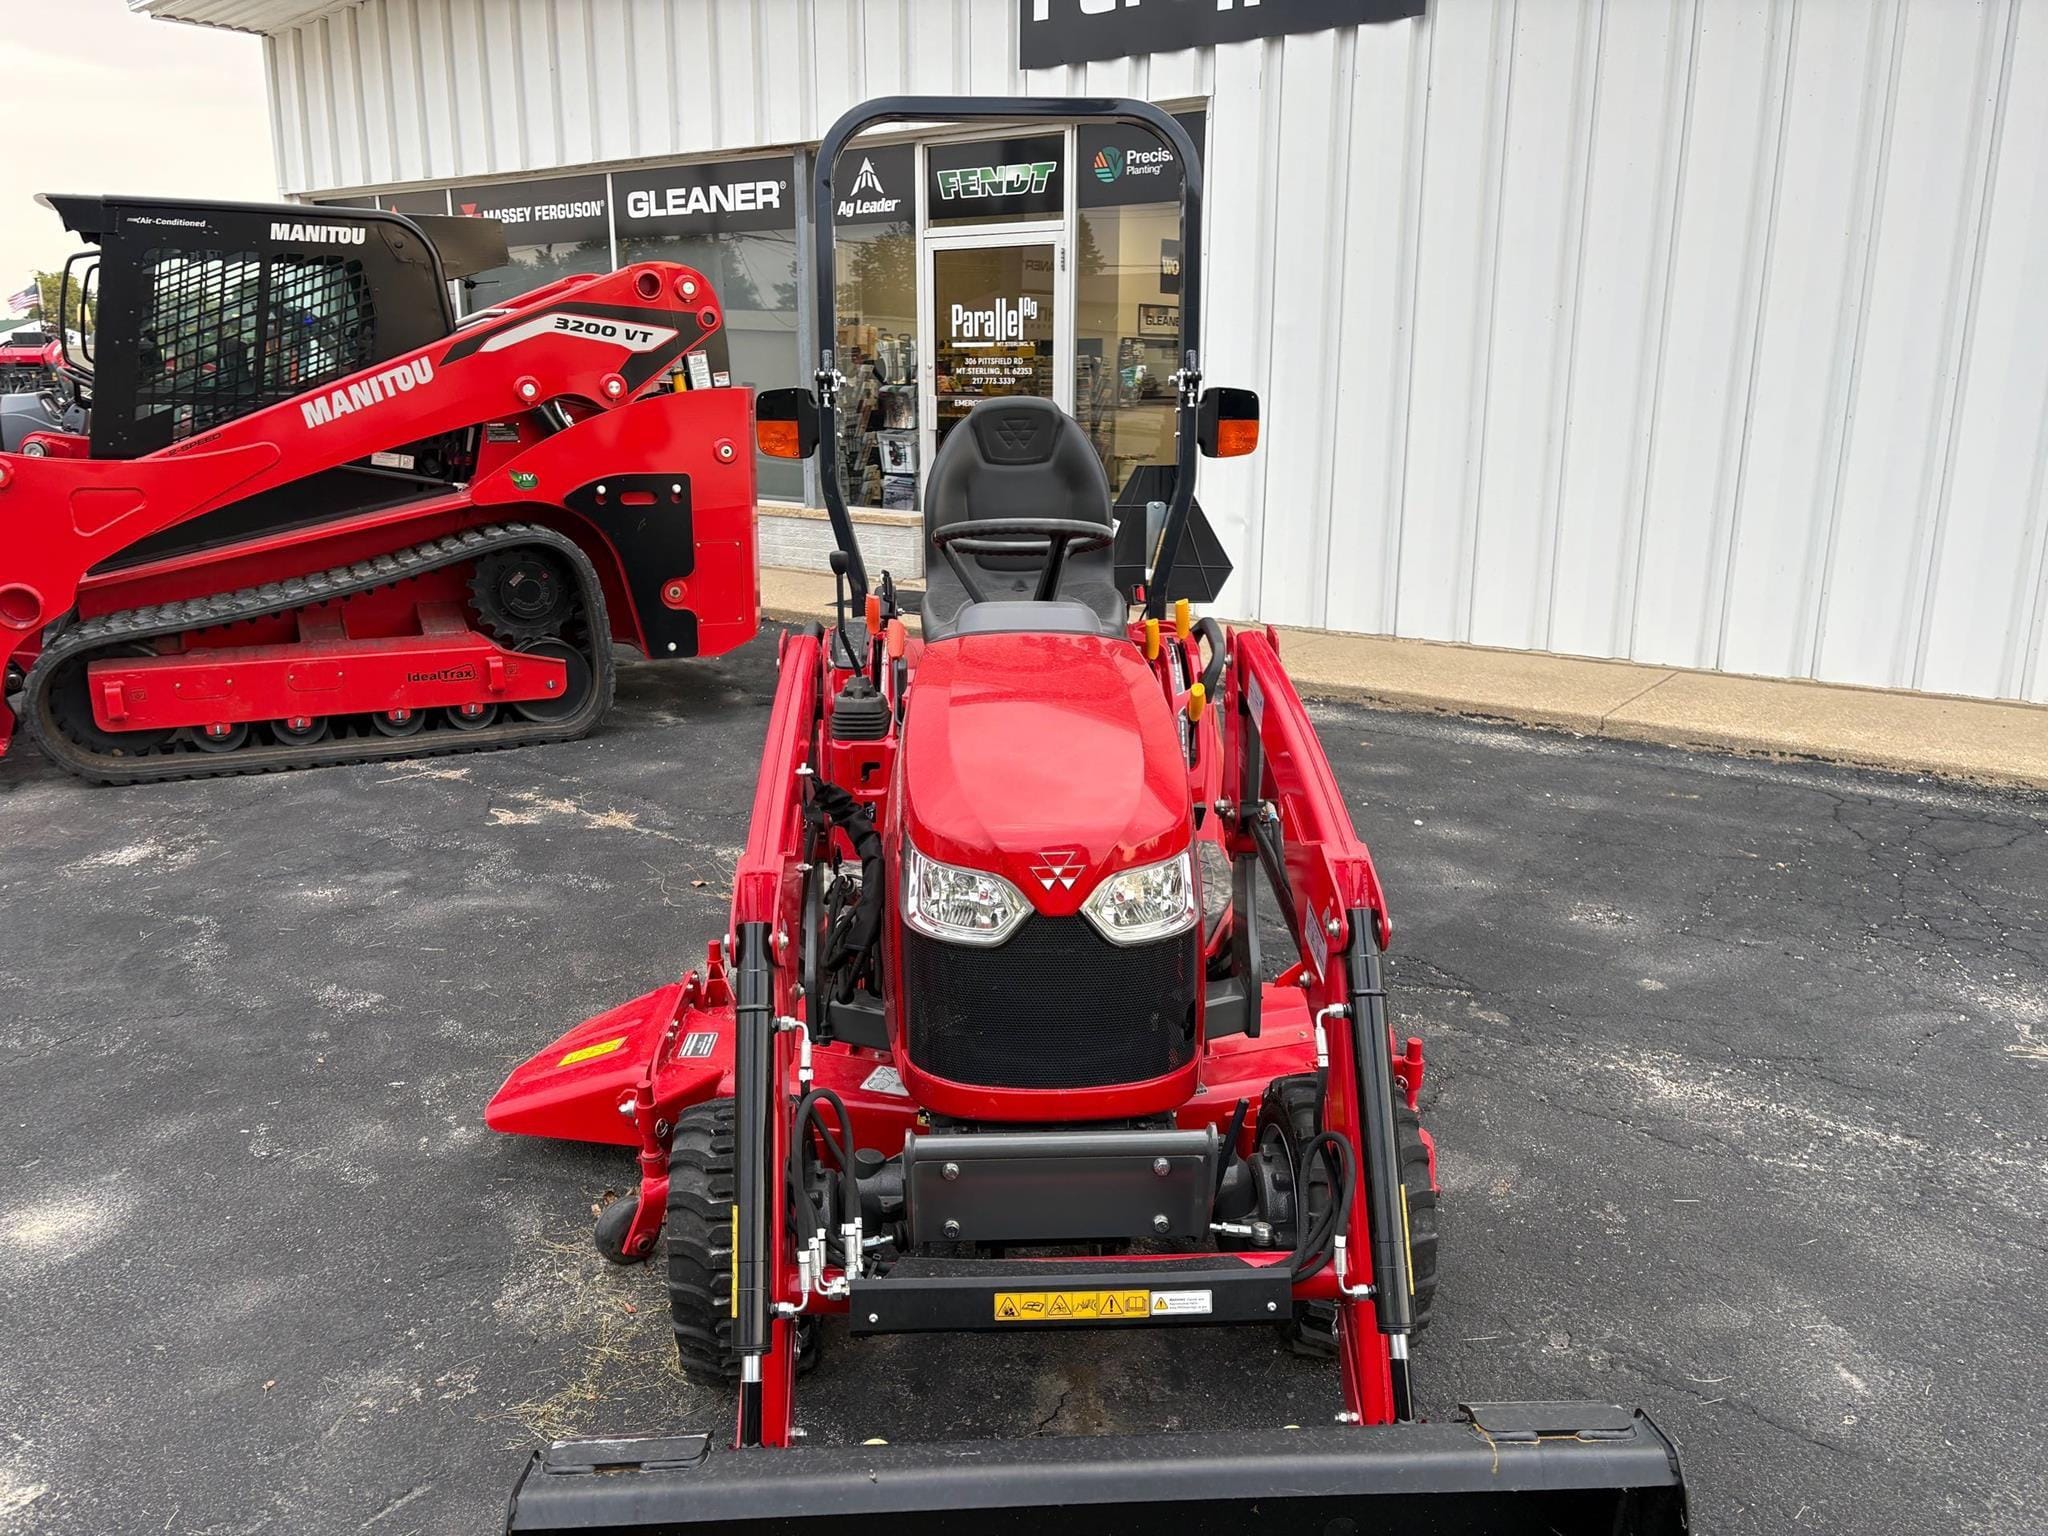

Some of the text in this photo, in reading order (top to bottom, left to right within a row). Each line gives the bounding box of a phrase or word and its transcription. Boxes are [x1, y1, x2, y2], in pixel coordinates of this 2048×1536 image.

[1126, 147, 1174, 166] Precis
[936, 161, 1058, 200] FENDT
[483, 206, 532, 224] MASSEY
[837, 198, 899, 218] Ag Leader
[139, 216, 207, 228] Air-Conditioned
[270, 222, 366, 245] MANITOU
[951, 296, 1038, 341] Parallel Ag
[554, 317, 654, 344] 3200 VT
[964, 357, 1024, 366] 306 PITTSFIELD RD
[972, 377, 1016, 385] 217.773.3339
[1004, 367, 1010, 375] IL
[1012, 367, 1033, 376] 62353
[300, 355, 434, 430] MANITOU
[407, 668, 474, 683] IdealTrax
